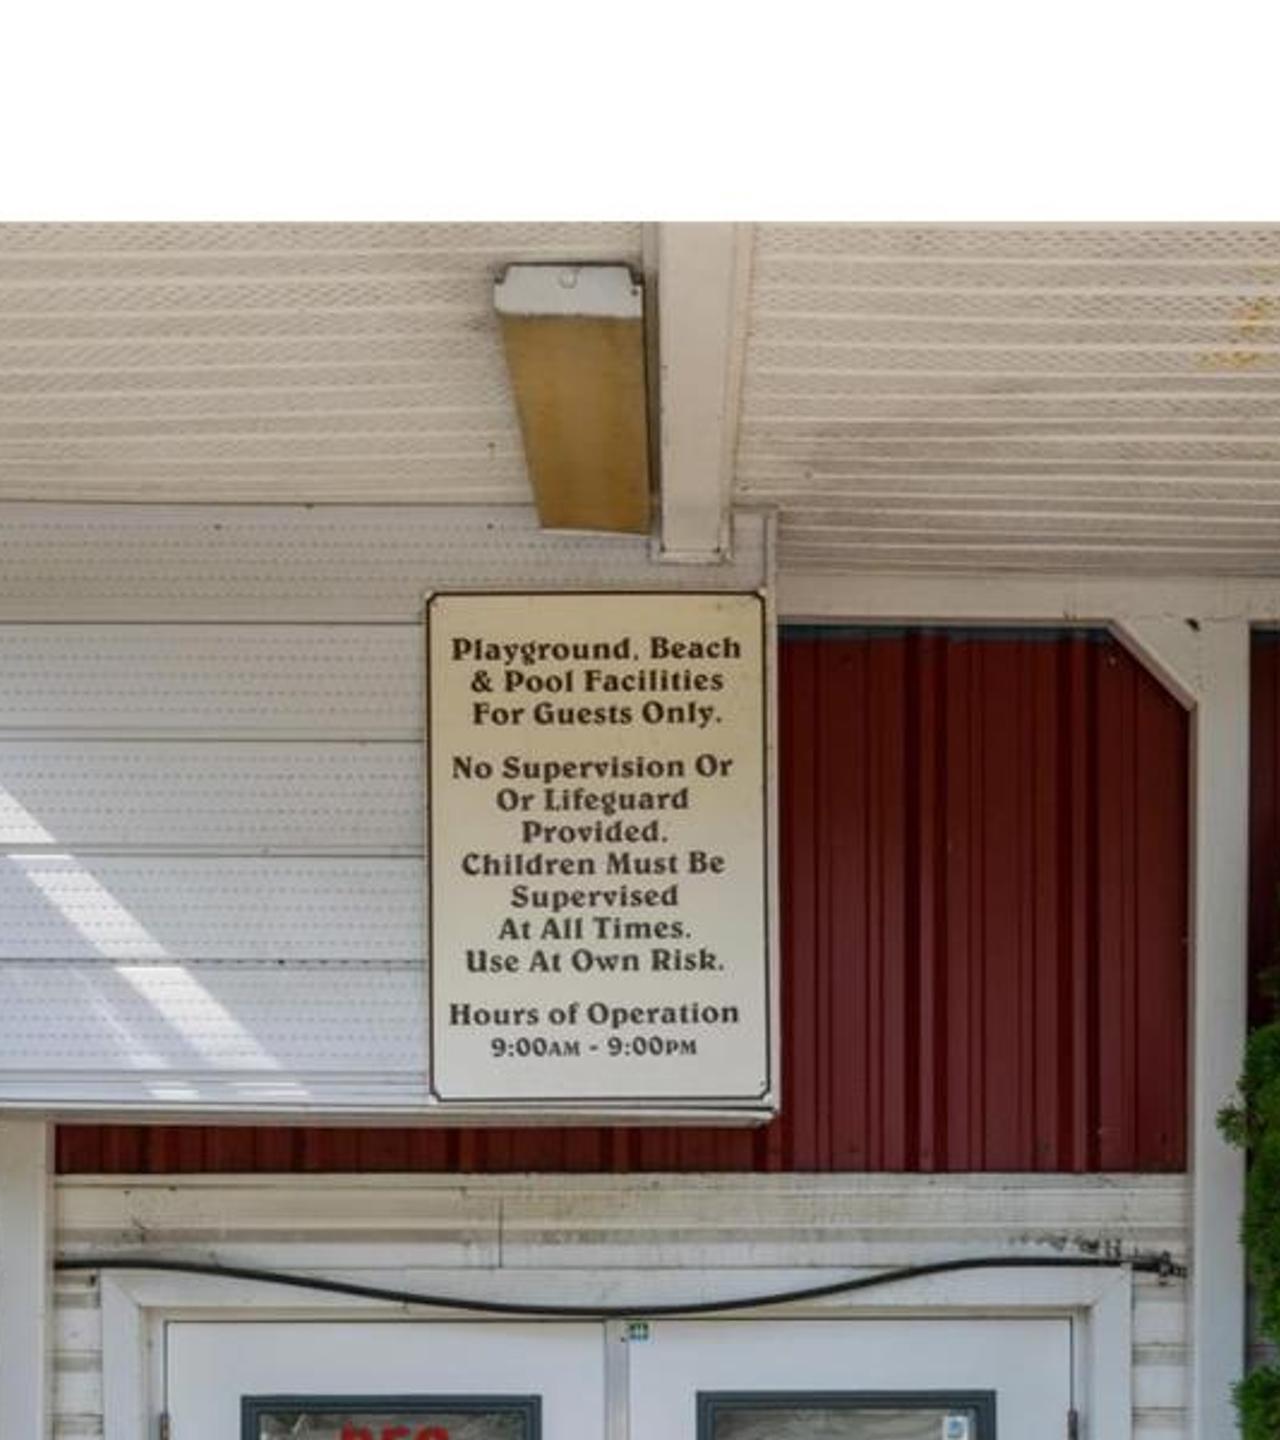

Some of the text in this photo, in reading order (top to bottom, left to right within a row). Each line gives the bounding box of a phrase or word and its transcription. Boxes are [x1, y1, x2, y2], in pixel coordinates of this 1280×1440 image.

[650, 635, 741, 660] Beach
[470, 669, 724, 694] & Pool Facilities
[472, 700, 723, 729] For Guests Only.
[452, 753, 734, 784] No Supervision Or
[496, 787, 690, 816] Or Lifeguard
[521, 820, 668, 844] Provided.
[461, 850, 725, 877] Children Must Be
[510, 884, 679, 913] Supervised
[498, 916, 692, 941] At All Times.
[465, 948, 725, 974] Use At Own Risk.
[449, 1001, 739, 1030] Hours of Operation
